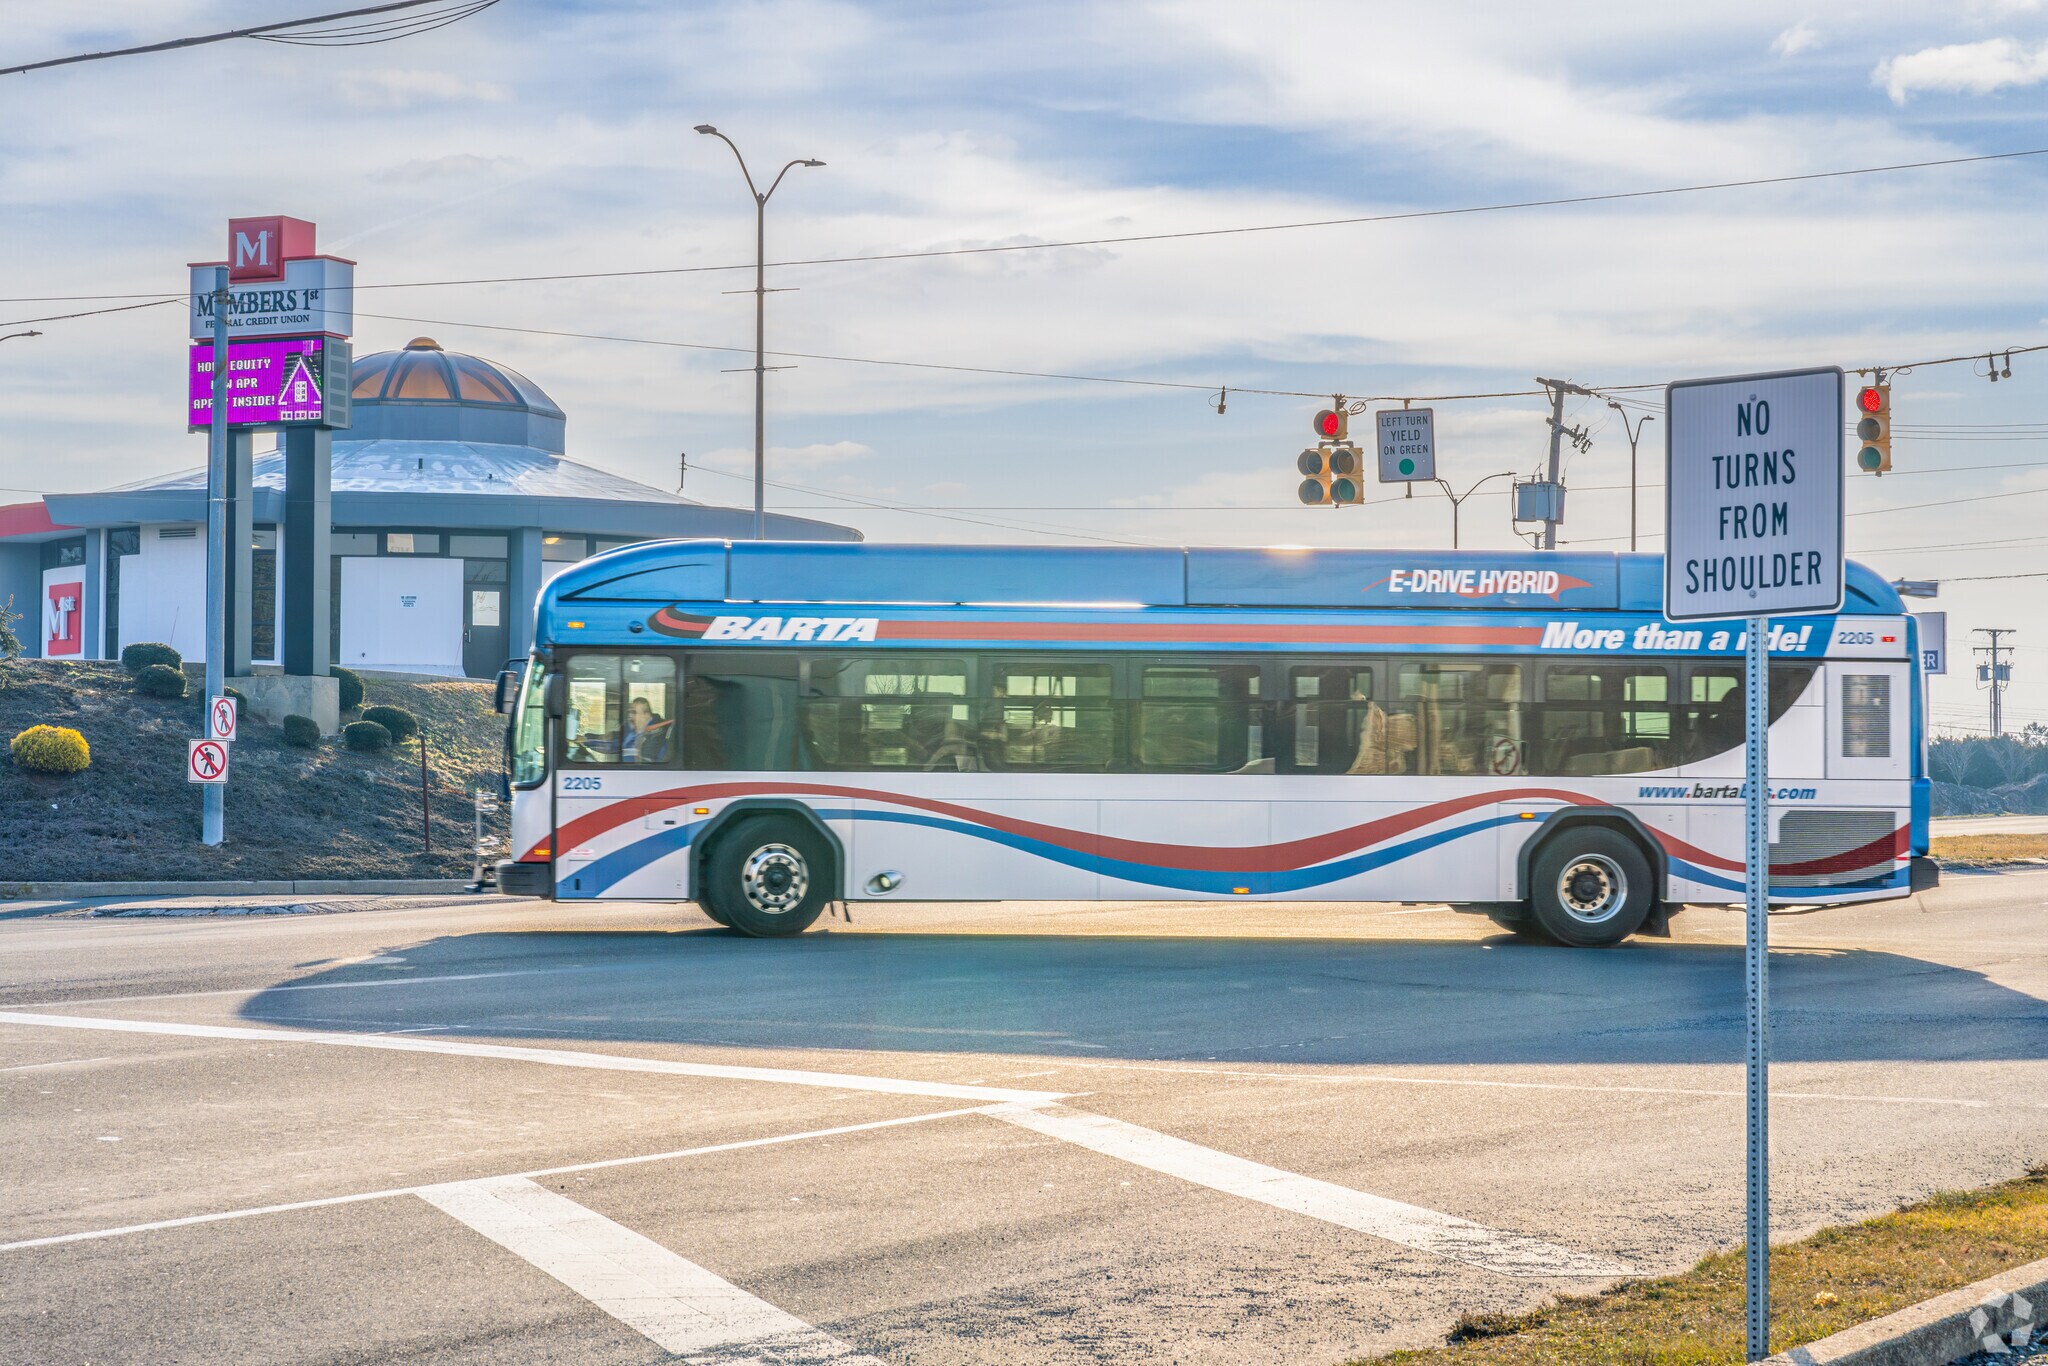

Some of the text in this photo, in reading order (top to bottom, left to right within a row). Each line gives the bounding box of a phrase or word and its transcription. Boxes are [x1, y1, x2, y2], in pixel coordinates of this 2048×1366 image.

[196, 288, 320, 317] MMBERS 1st
[205, 314, 310, 329] FEAL CREDIT UNION
[229, 358, 271, 371] EQUITY
[236, 377, 258, 389] APR
[193, 395, 275, 410] APP INSIDE!
[1381, 415, 1429, 427] LEFT TURN
[1737, 400, 1770, 437] NO
[1390, 429, 1421, 442] YIELD
[1383, 444, 1429, 456] ON GREEN
[1711, 448, 1796, 490] TURNS
[1719, 501, 1788, 540] FROM
[1685, 550, 1822, 594] SHOULDER
[1388, 569, 1559, 594] E-DRIVE HYBRID
[701, 616, 880, 642] BARTA
[1540, 621, 1813, 652] More than a rde!
[1838, 631, 1874, 645] 2205
[563, 776, 603, 790] 2205
[1638, 783, 1817, 800] www.barta.com
